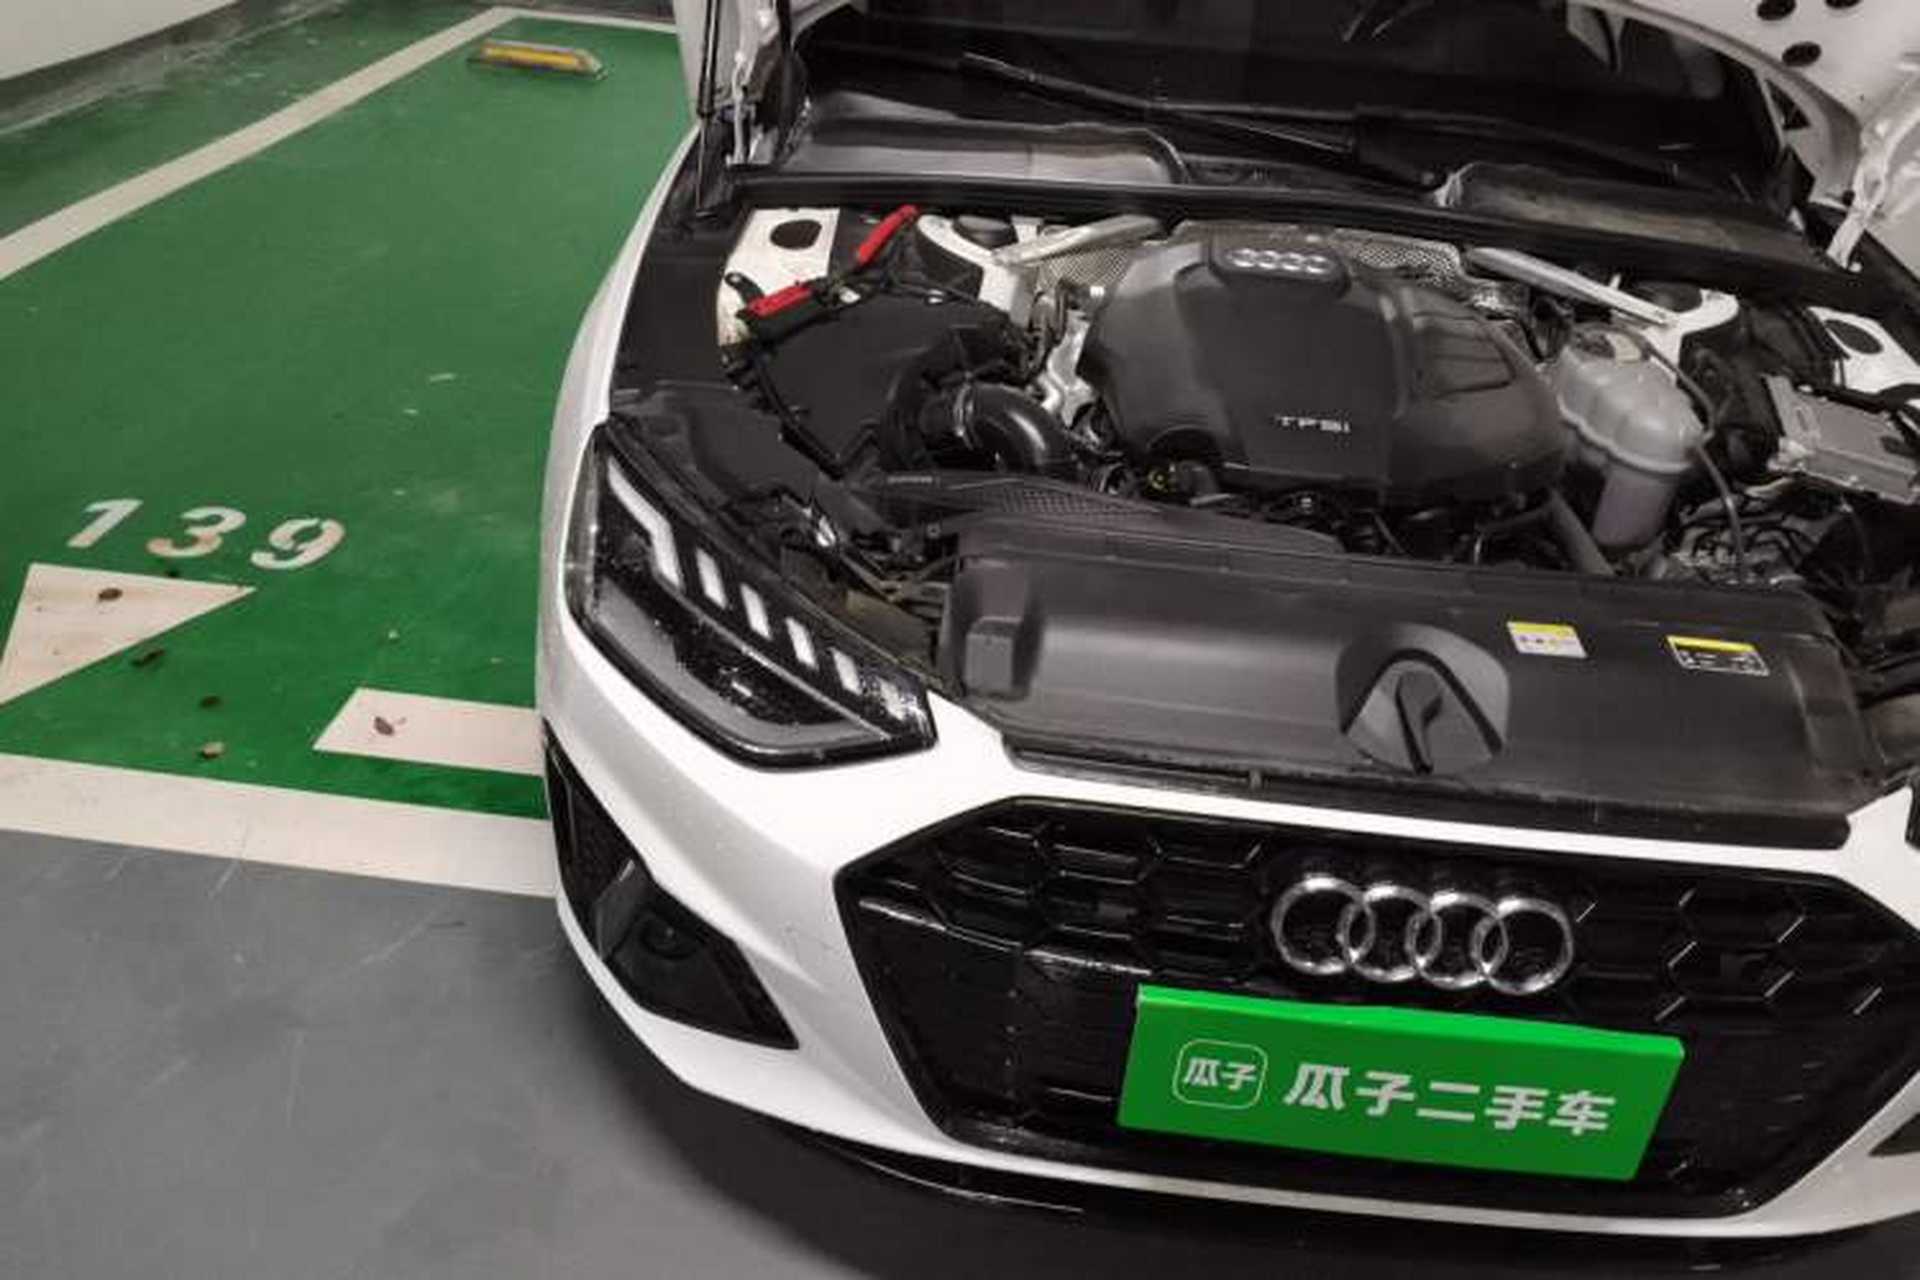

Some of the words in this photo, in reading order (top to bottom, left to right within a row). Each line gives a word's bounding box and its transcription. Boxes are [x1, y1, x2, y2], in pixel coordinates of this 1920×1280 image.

[66, 498, 345, 569] 139
[1184, 1057, 1257, 1090] 瓜子
[1283, 1062, 1616, 1135] 瓜子二手车
